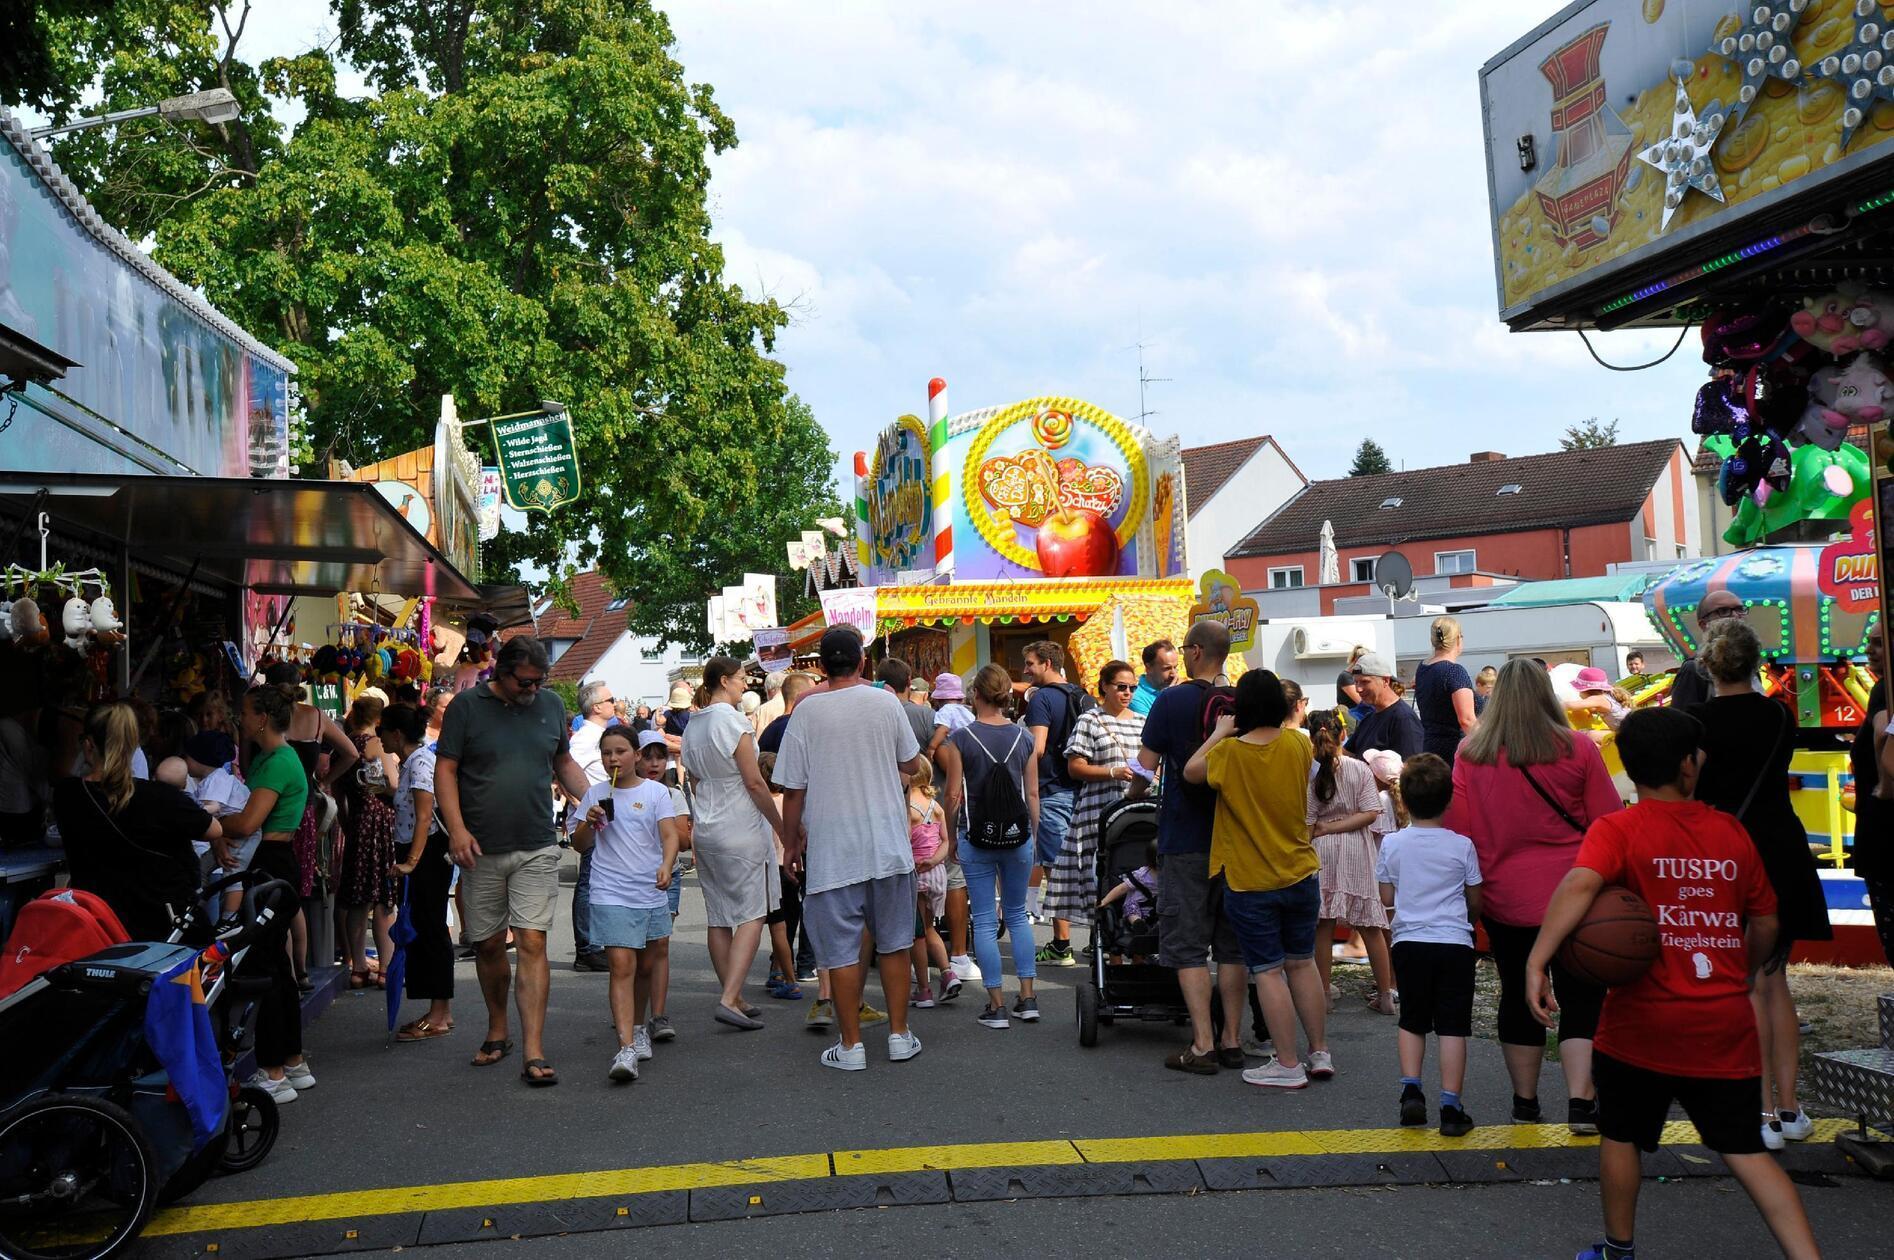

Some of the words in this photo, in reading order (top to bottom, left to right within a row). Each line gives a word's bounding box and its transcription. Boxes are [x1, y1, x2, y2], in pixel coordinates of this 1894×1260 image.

[530, 433, 548, 445] Jagd
[509, 444, 562, 458] Sternschießen
[511, 454, 571, 468] Walzenschießen
[513, 466, 565, 479] Herzschießen
[924, 593, 978, 606] Gebrannte
[983, 591, 1028, 604] Mandeln
[1851, 587, 1873, 600] DER
[829, 607, 871, 630] Mandeln
[1834, 706, 1855, 721] 12
[1653, 858, 1738, 881] TUSPO
[1678, 886, 1714, 900] goes
[1657, 904, 1739, 928] Kärwa
[1660, 932, 1741, 950] Ziegelstein
[86, 967, 116, 978] THULE
